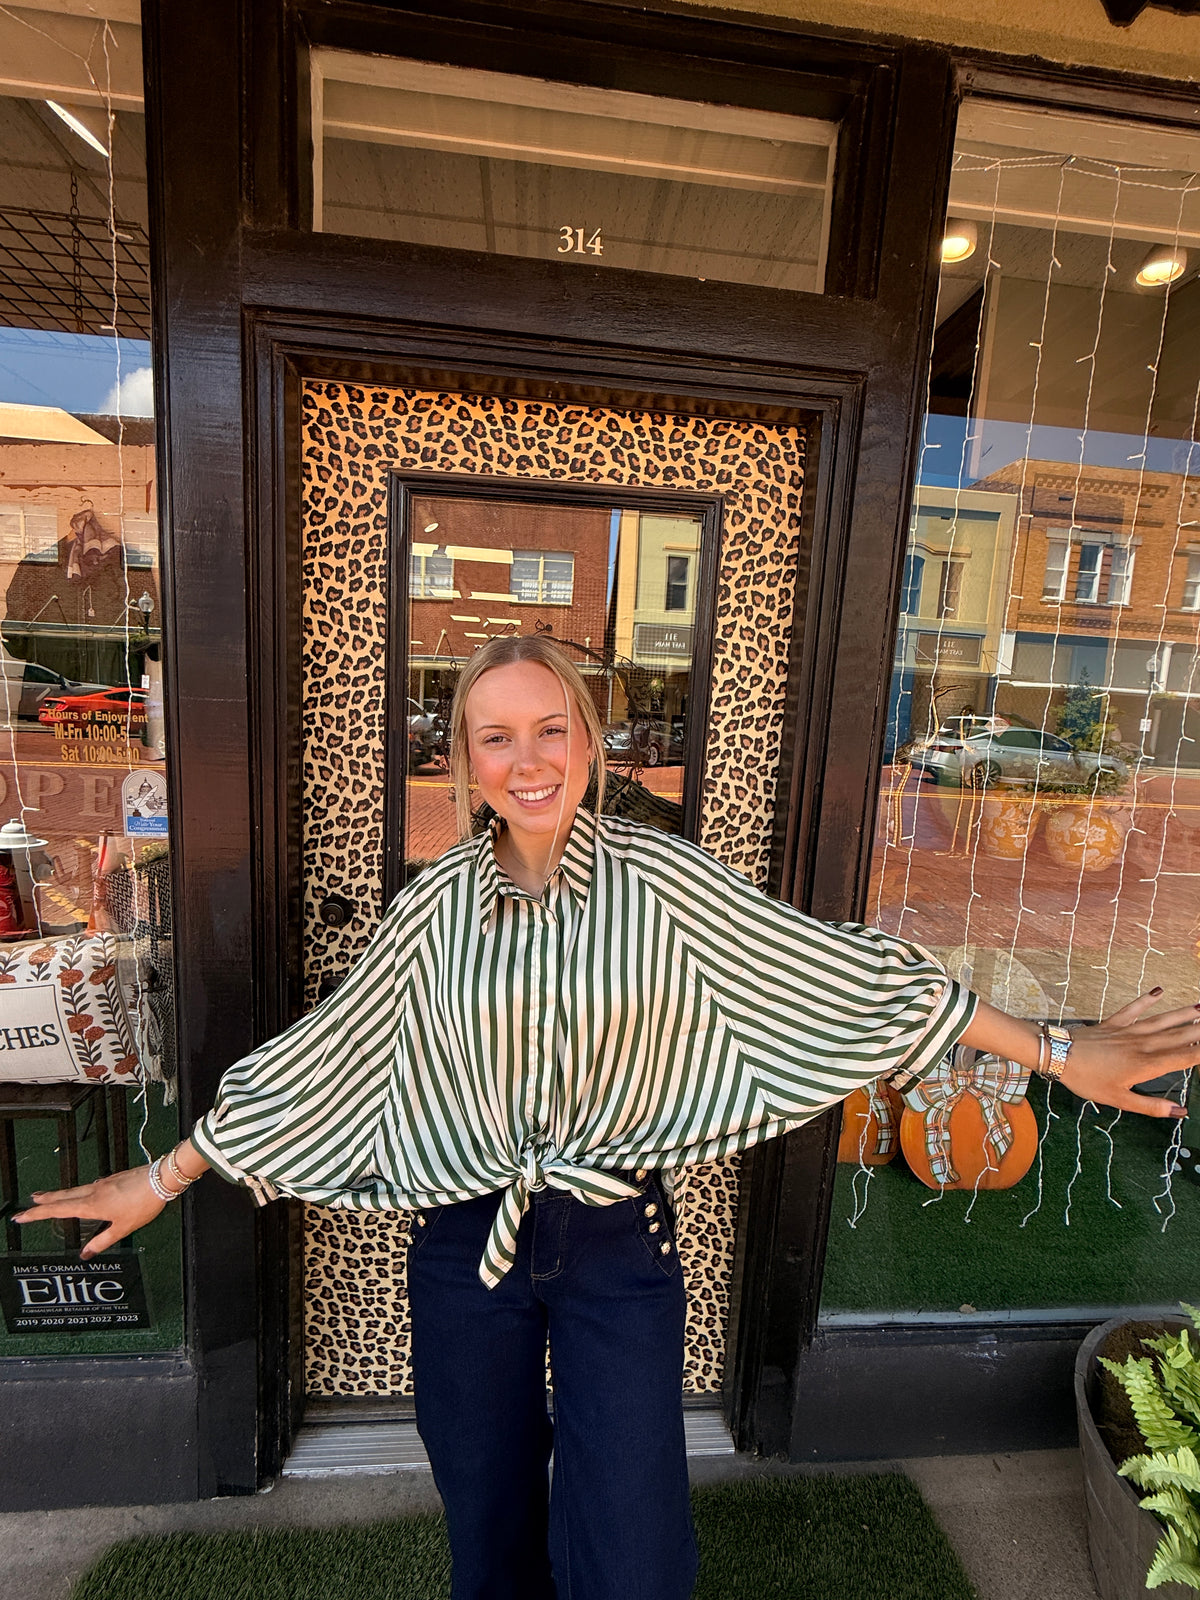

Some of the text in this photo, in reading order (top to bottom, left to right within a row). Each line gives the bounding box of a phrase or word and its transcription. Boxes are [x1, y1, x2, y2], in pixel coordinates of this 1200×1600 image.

[557, 225, 604, 256] 314
[48, 709, 79, 720] Hours
[82, 710, 93, 721] of
[54, 722, 83, 740] M-Fri
[61, 744, 80, 762] Sat
[0, 1023, 60, 1051] HES
[13, 1263, 122, 1275] JIM'S FORMAL WEAR
[18, 1274, 125, 1306] Elite
[67, 1317, 89, 1325] 2021
[116, 1314, 139, 1322] 2023
